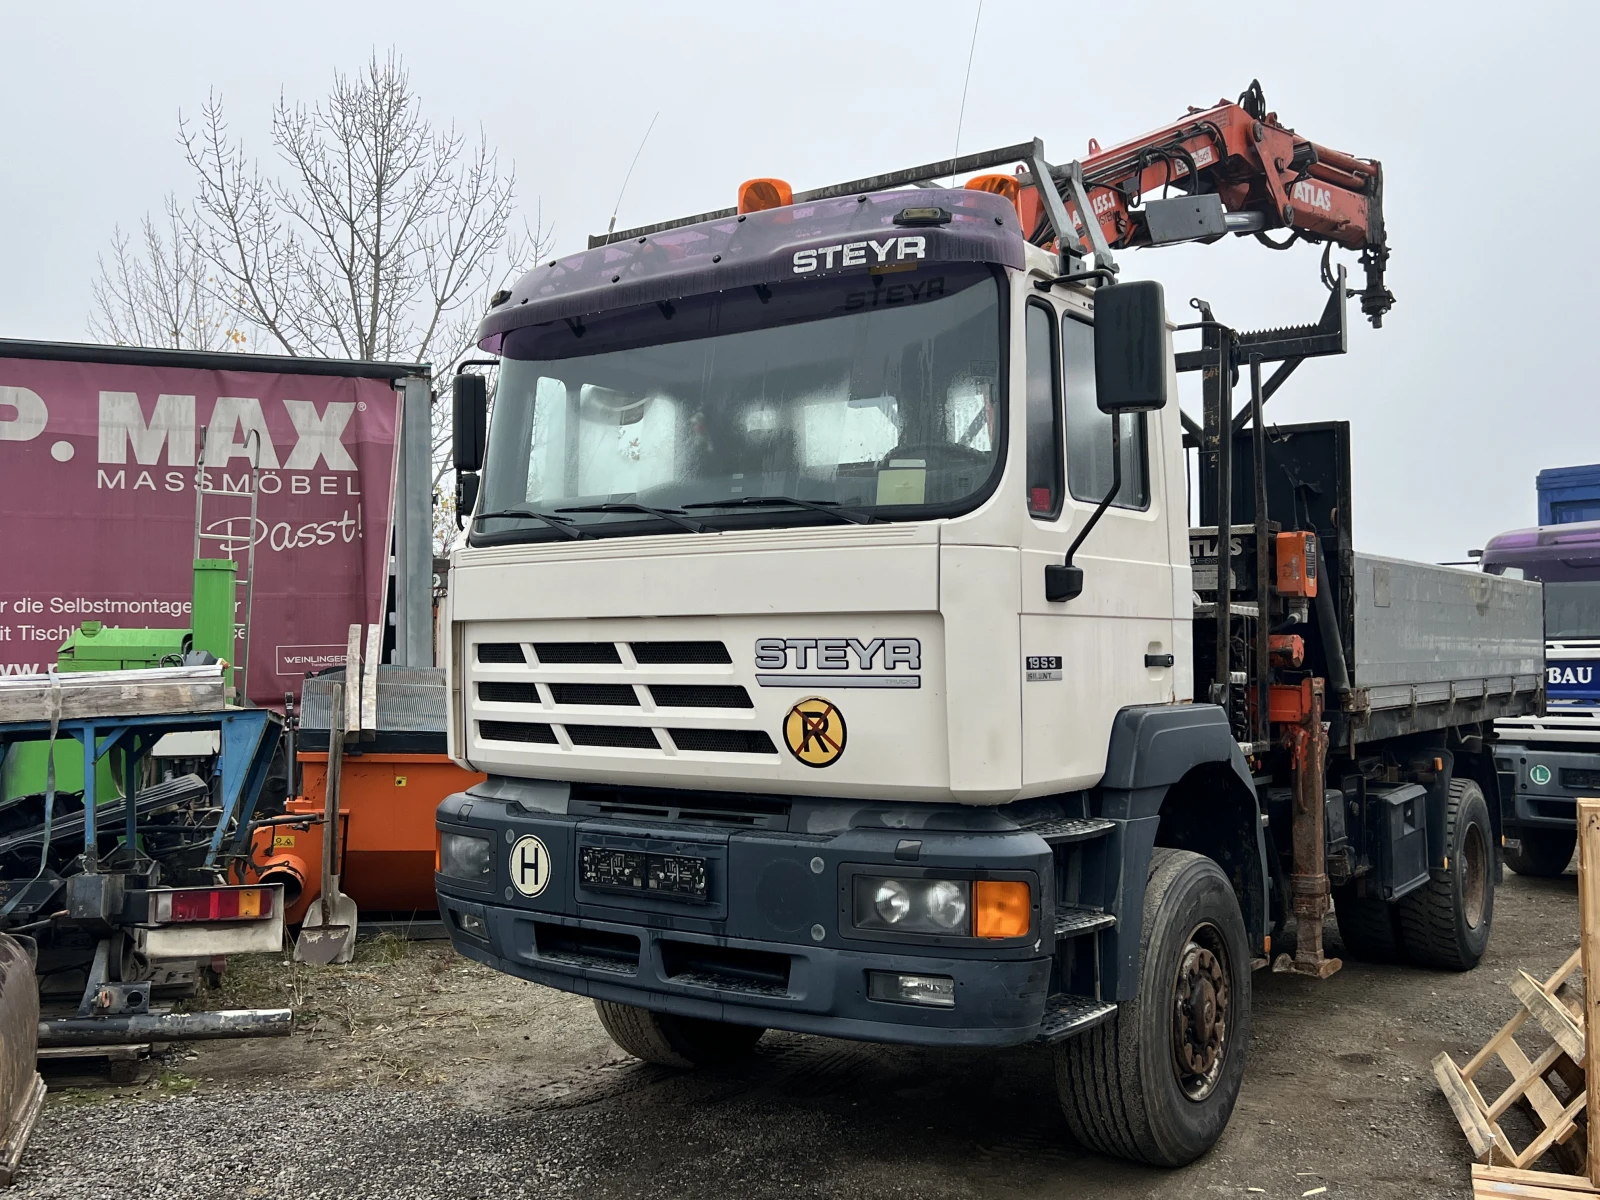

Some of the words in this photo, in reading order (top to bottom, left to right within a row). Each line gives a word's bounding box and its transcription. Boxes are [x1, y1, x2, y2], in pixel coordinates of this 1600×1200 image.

[1092, 191, 1116, 215] 155.1
[1293, 181, 1331, 211] ATLAS
[792, 236, 926, 274] STEYR
[845, 276, 945, 311] STEYR
[97, 470, 361, 495] MASSMÖBEL
[1190, 538, 1243, 558] TLS
[14, 598, 44, 613] die
[50, 597, 192, 617] Selbstmontage
[755, 638, 921, 670] STEYR
[1546, 667, 1593, 684] BAU
[802, 711, 829, 753] R
[520, 846, 539, 885] H
